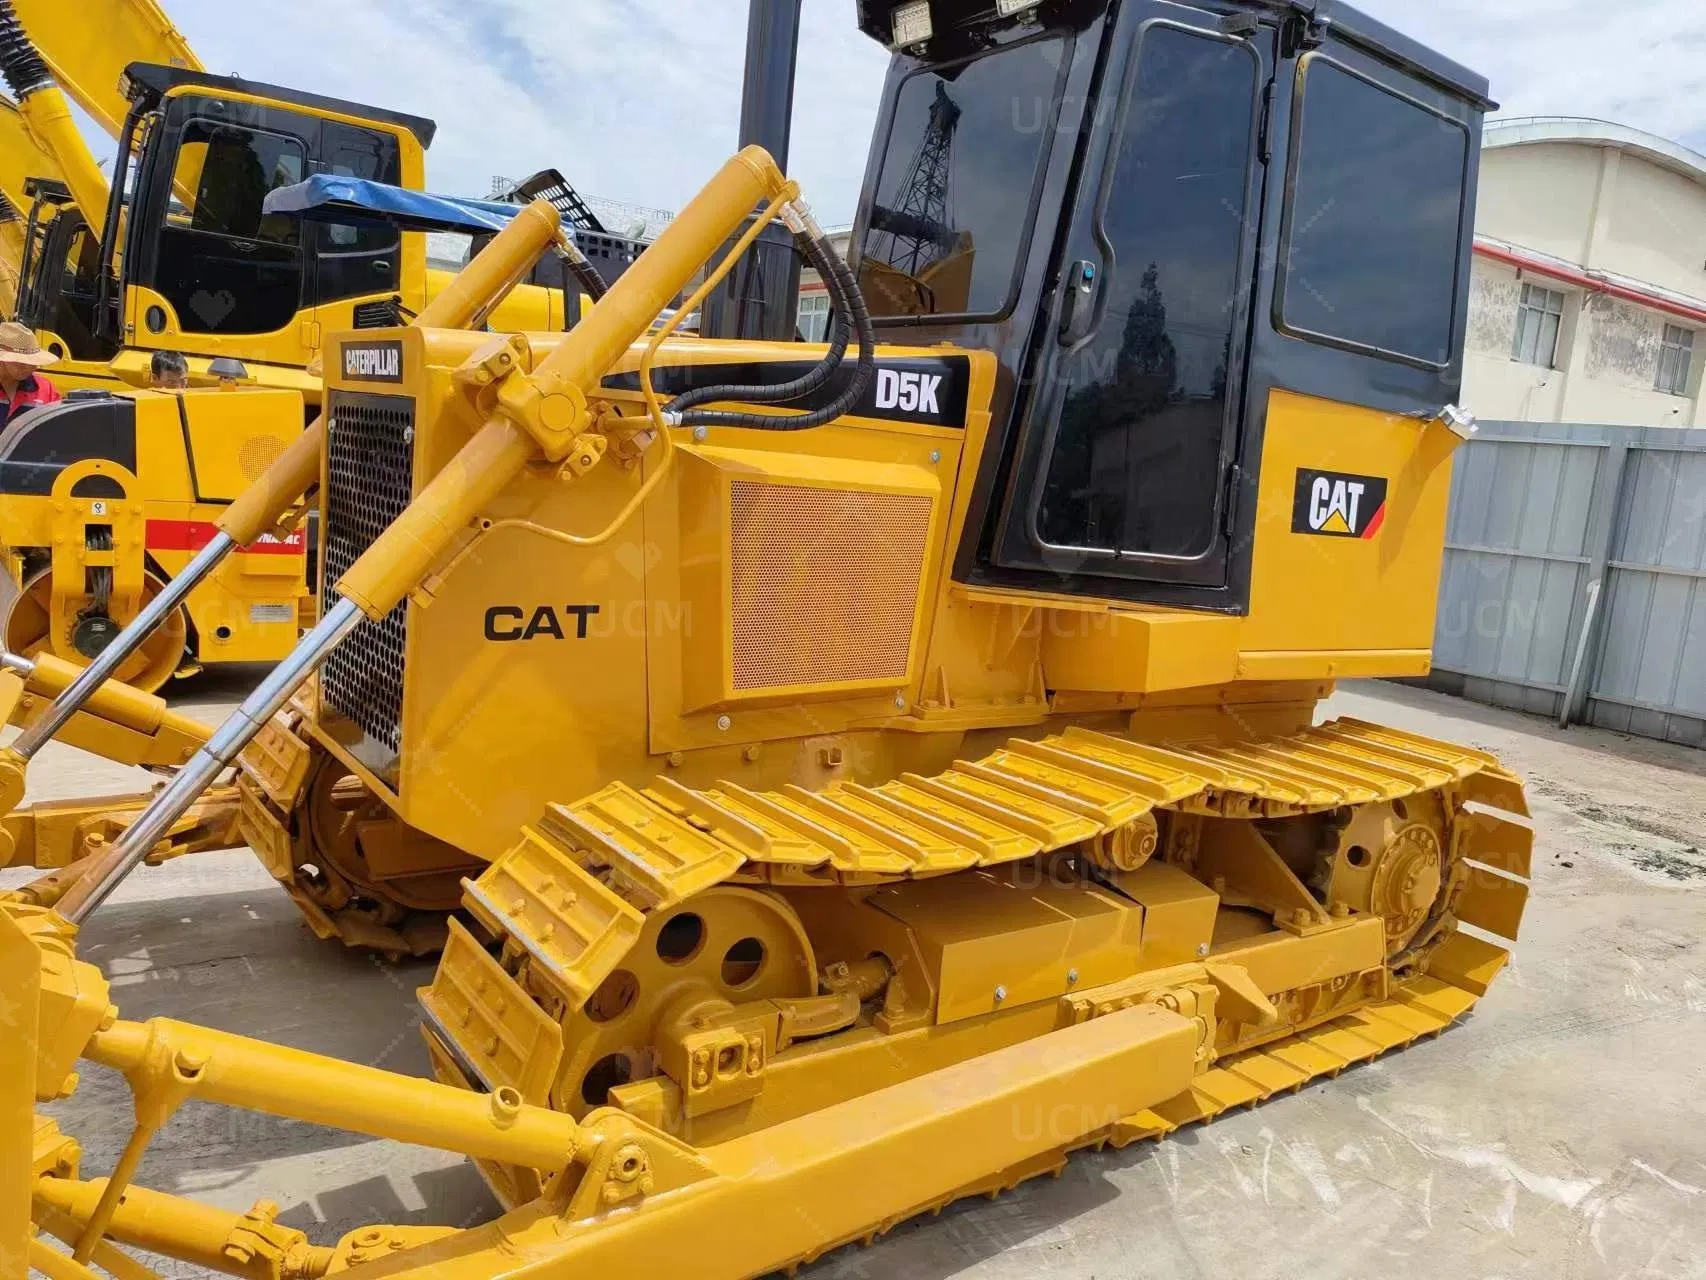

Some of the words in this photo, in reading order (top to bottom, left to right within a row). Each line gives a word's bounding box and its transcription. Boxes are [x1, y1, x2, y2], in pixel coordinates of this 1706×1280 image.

[346, 349, 399, 375] CATERPILLAR
[875, 368, 942, 414] D5K
[1309, 476, 1365, 533] CAT
[484, 605, 600, 641] CAT
